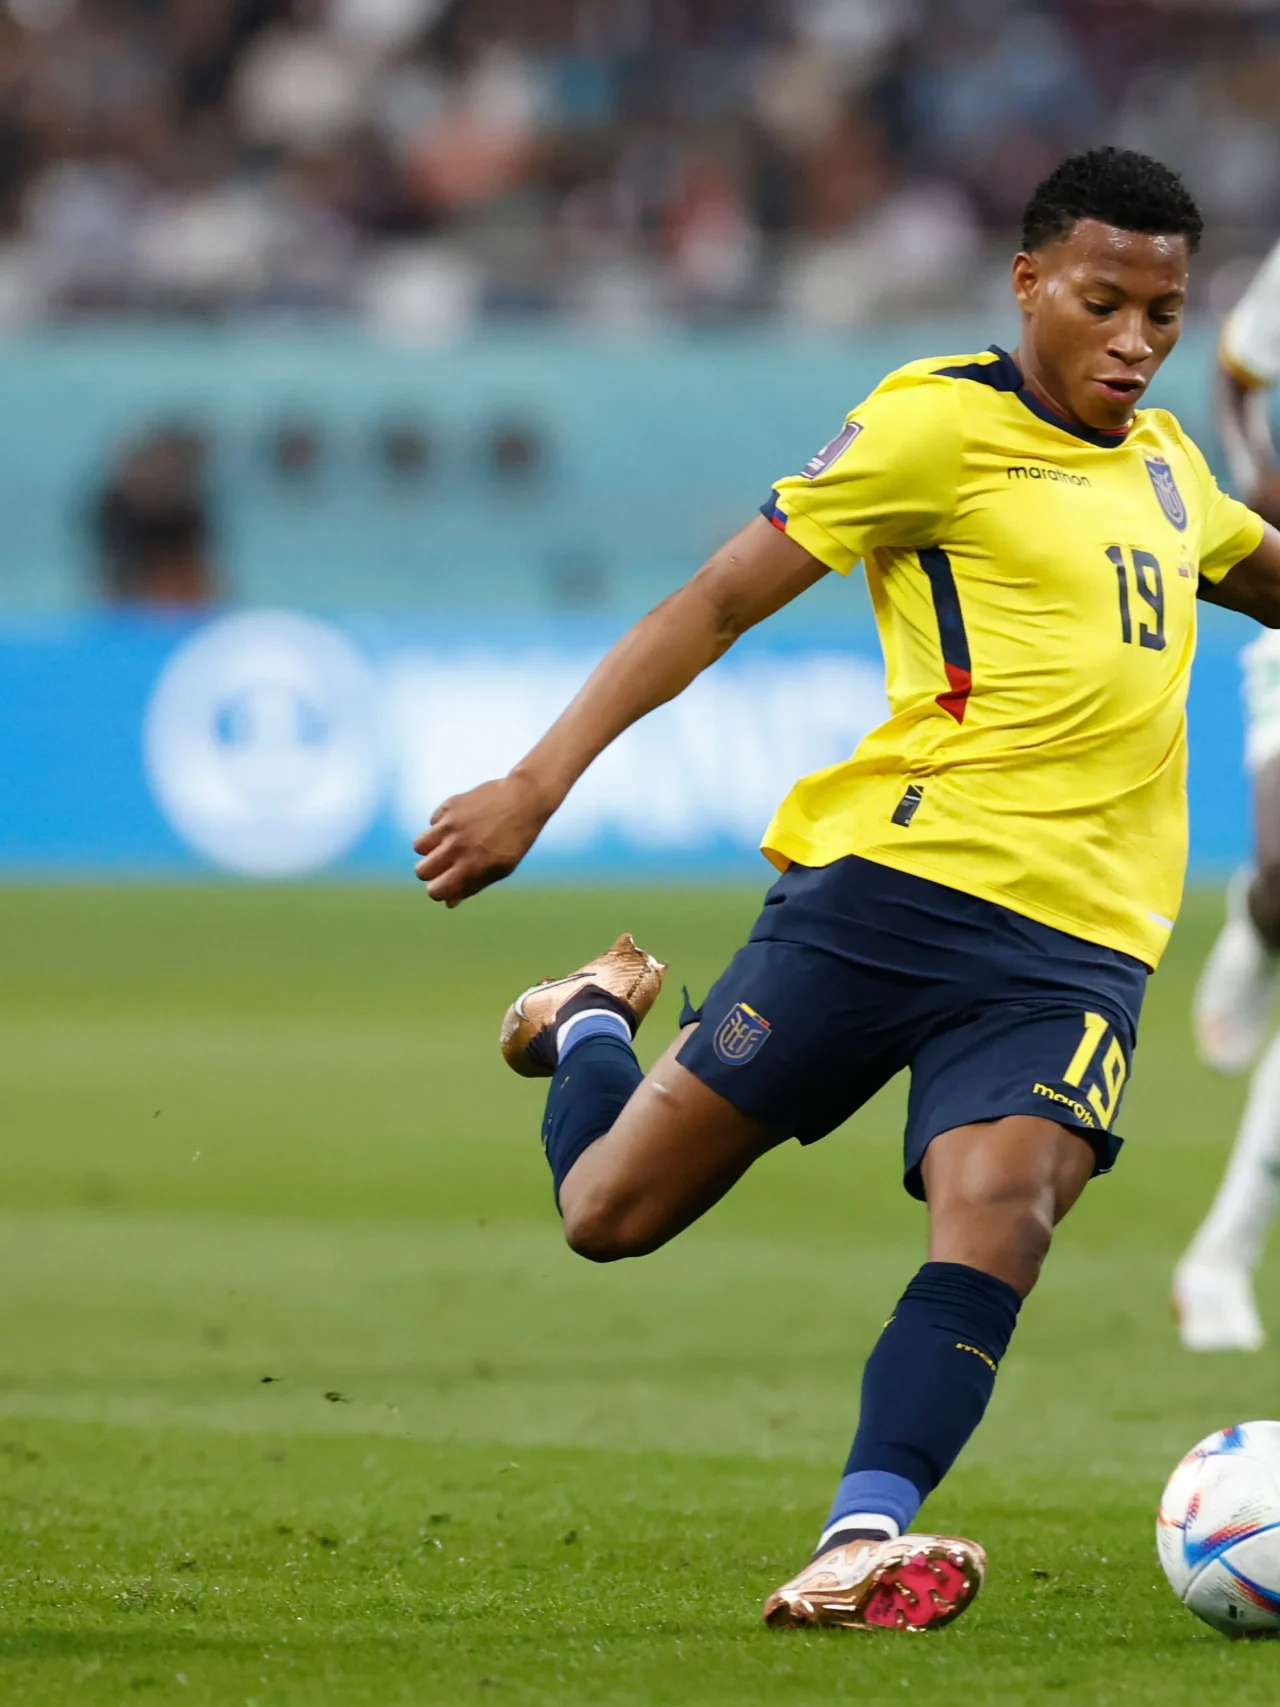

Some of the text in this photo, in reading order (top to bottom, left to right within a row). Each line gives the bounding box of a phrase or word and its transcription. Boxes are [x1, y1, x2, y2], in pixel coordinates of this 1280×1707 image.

[1007, 466, 1093, 487] marathon
[1104, 545, 1166, 651] 19
[1062, 1011, 1126, 1131] 19
